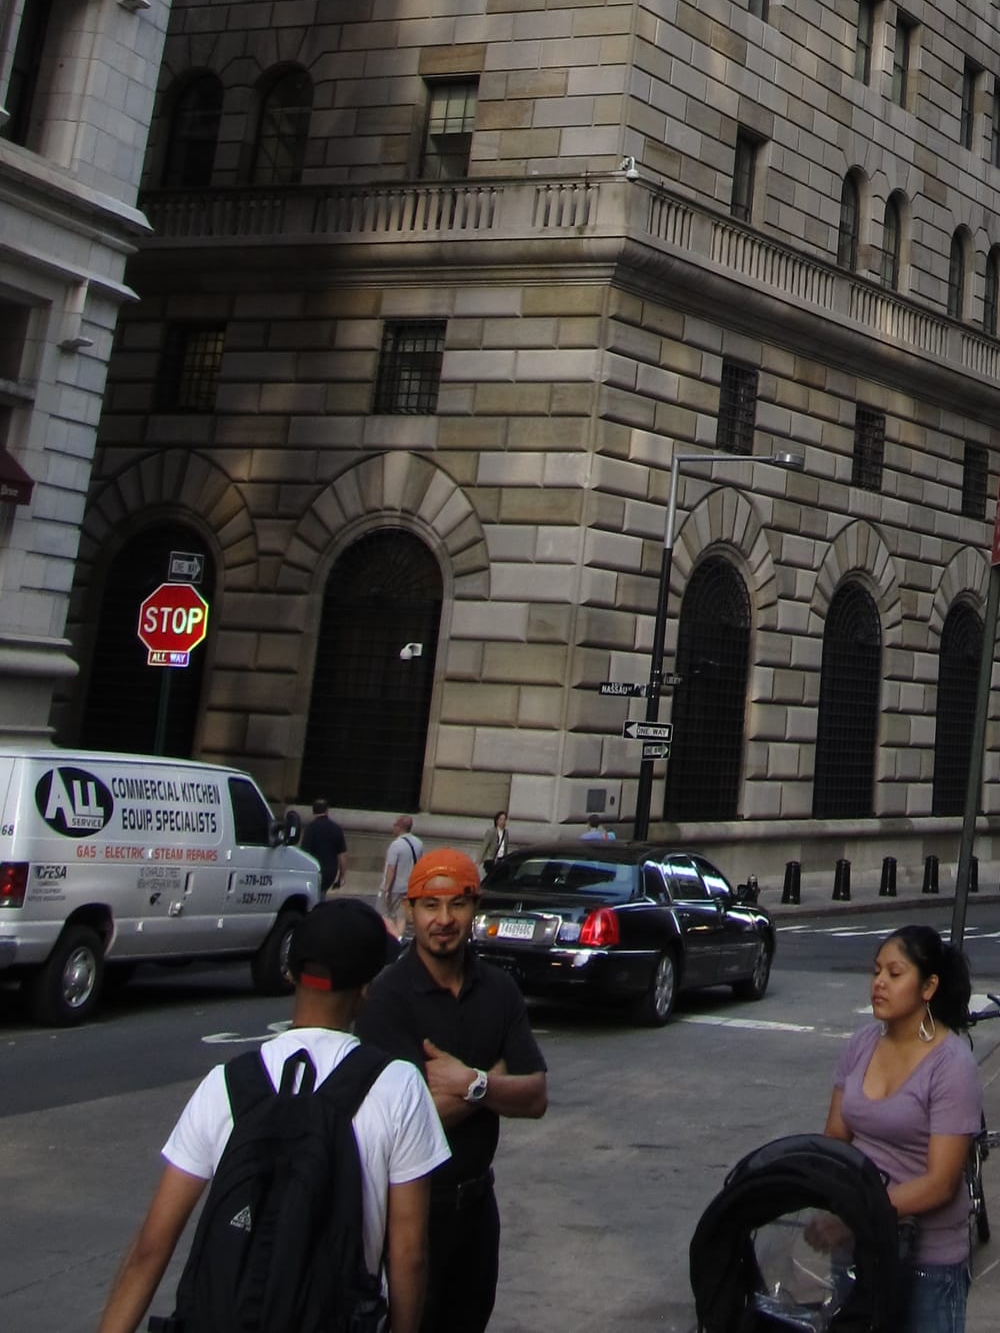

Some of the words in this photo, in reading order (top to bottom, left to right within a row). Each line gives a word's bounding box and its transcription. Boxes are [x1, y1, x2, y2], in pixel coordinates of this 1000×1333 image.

[143, 606, 204, 635] STOP
[151, 651, 167, 663] ALL
[169, 653, 187, 664] WAY
[601, 684, 628, 695] NASSAU
[637, 727, 649, 736] ONE
[652, 729, 667, 737] WAY
[45, 767, 104, 824] ALL
[111, 777, 180, 802] COMMERCIAL
[181, 781, 221, 805] KITCHEN
[72, 817, 103, 828] SERVICE
[121, 808, 153, 831] EQUIP.
[155, 809, 218, 834] SPECIALISTS
[76, 845, 97, 859] GAS
[104, 846, 145, 860] ELECTRIC
[153, 848, 184, 861] STEAM
[185, 849, 218, 862] REPAIRS
